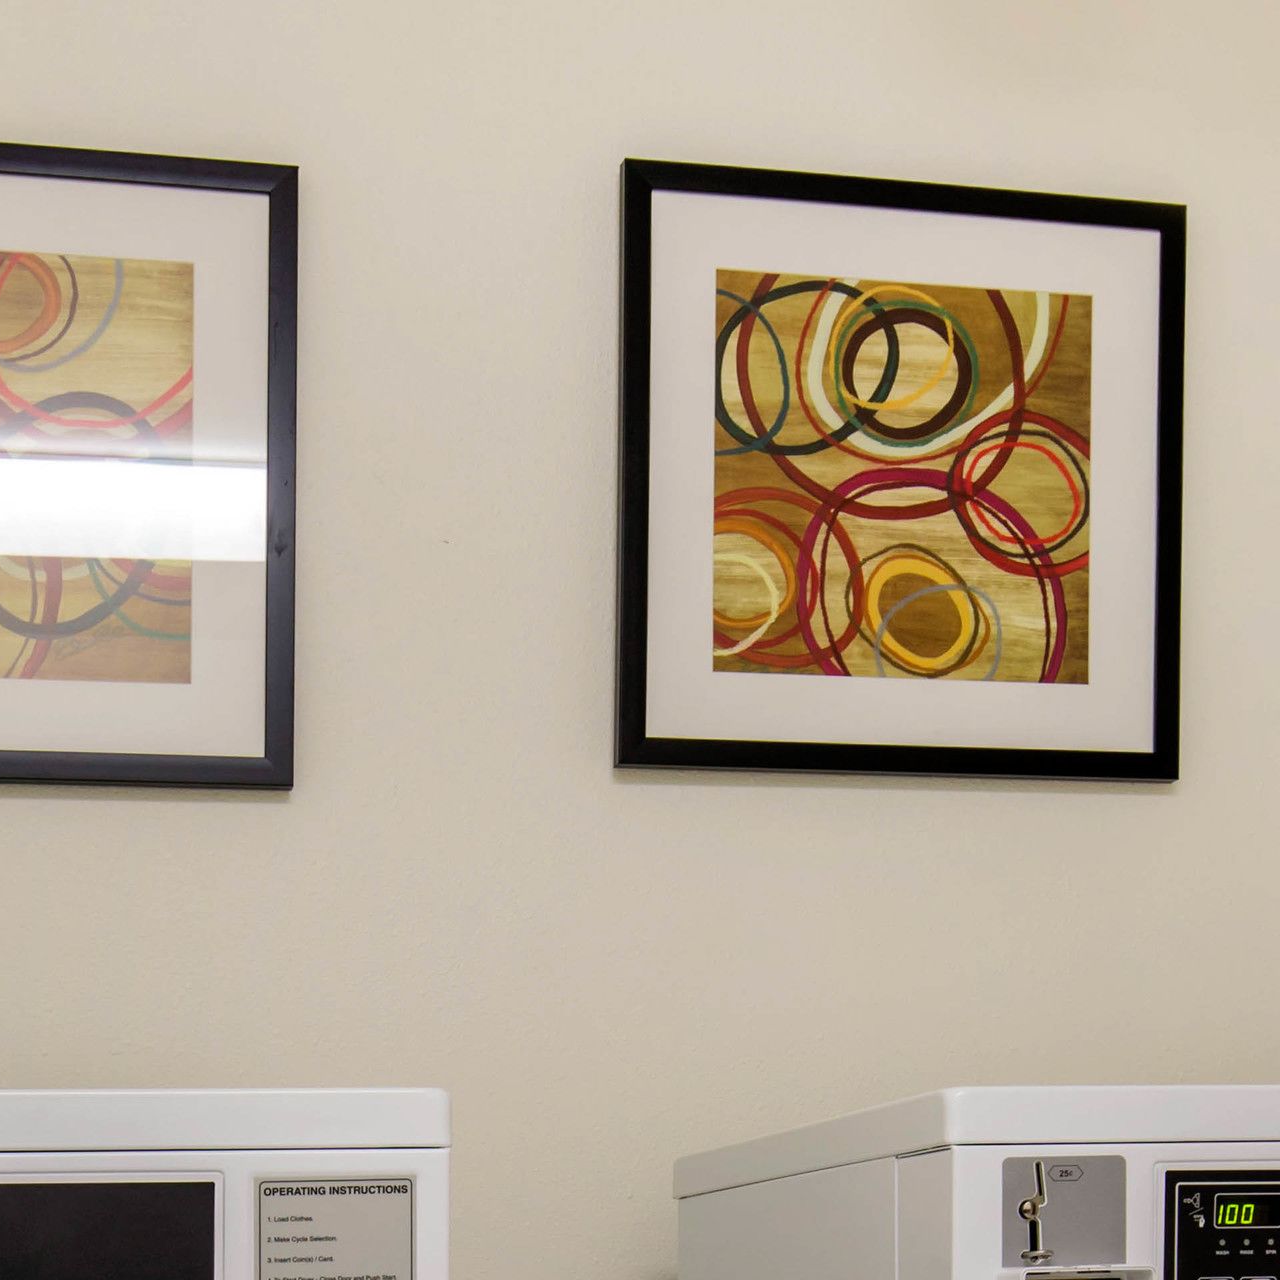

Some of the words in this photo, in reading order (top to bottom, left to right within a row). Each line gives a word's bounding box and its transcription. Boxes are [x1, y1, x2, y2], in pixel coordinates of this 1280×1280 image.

[263, 1186, 326, 1197] OPERATING
[329, 1185, 409, 1196] INSTRUCTIONS
[1217, 1204, 1255, 1225] 100
